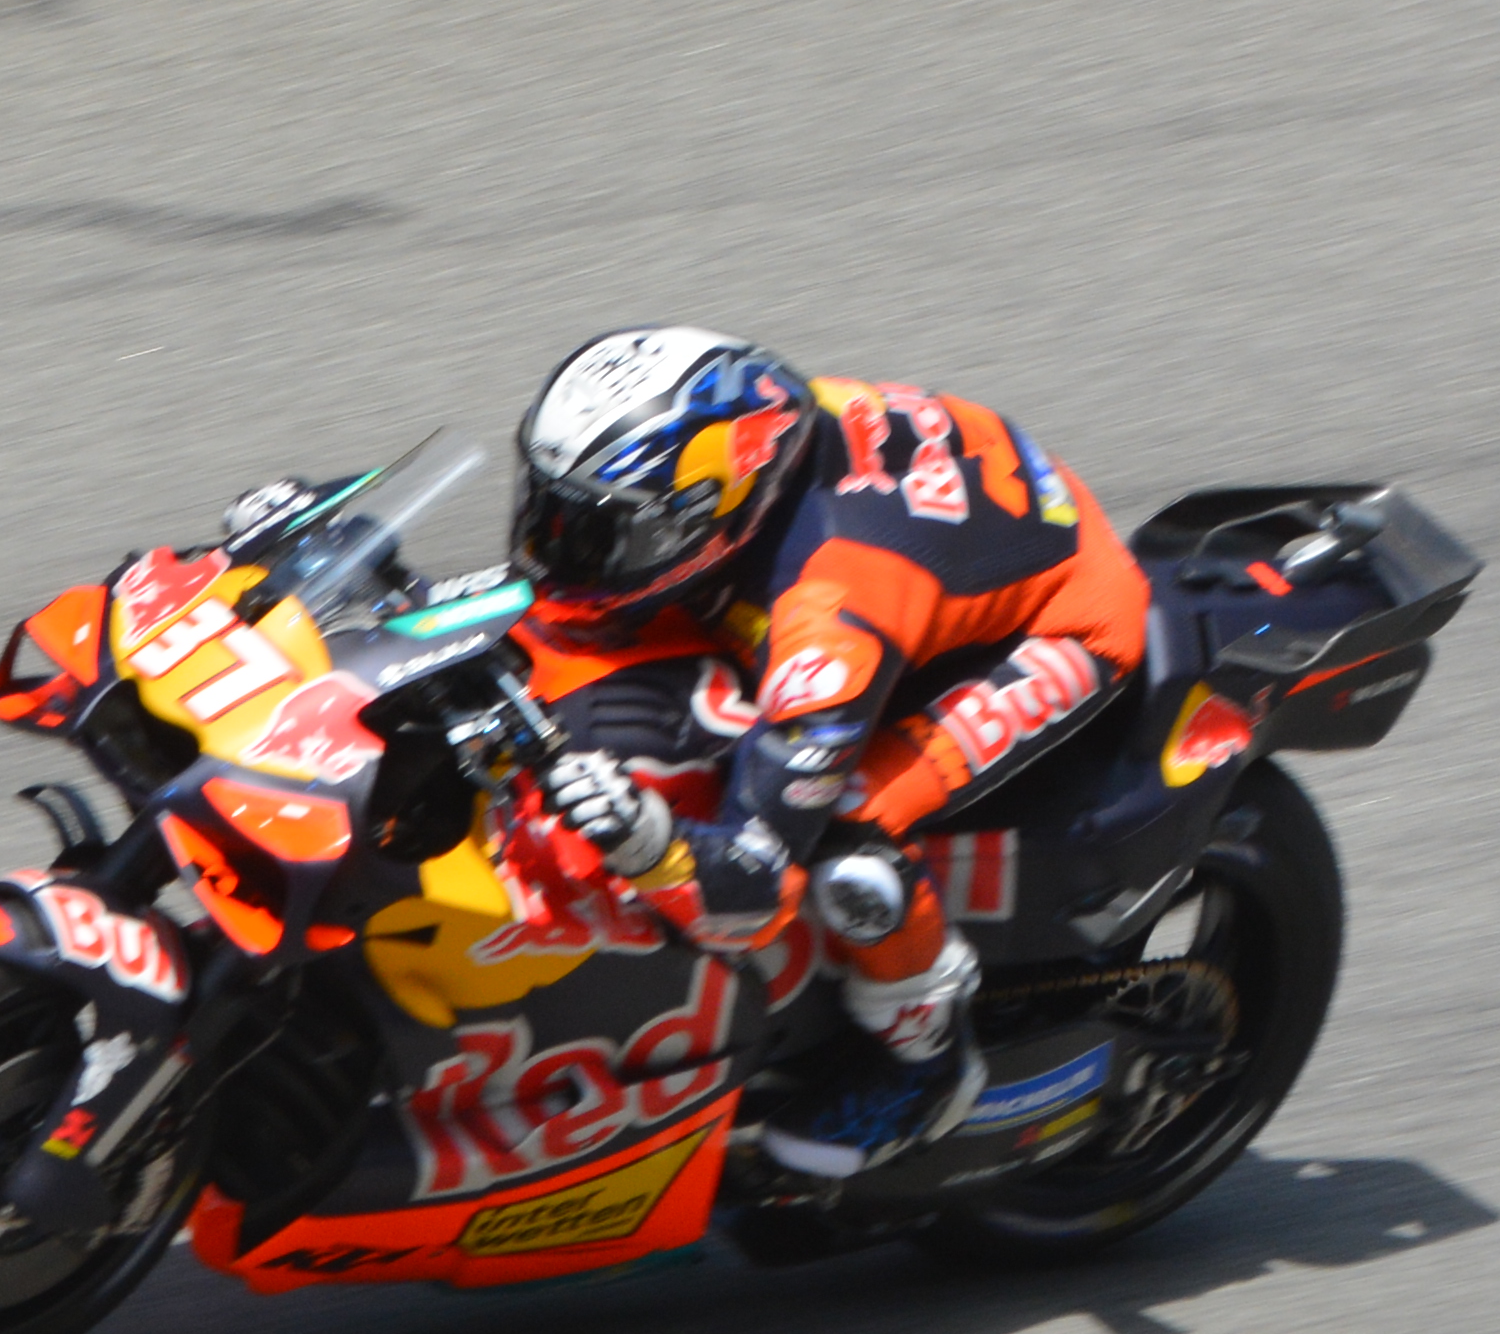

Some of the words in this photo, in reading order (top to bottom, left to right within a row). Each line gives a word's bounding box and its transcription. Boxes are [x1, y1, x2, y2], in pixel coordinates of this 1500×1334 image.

[126, 596, 302, 725] 37
[928, 635, 1101, 776] Bull
[402, 954, 742, 1204] Red
